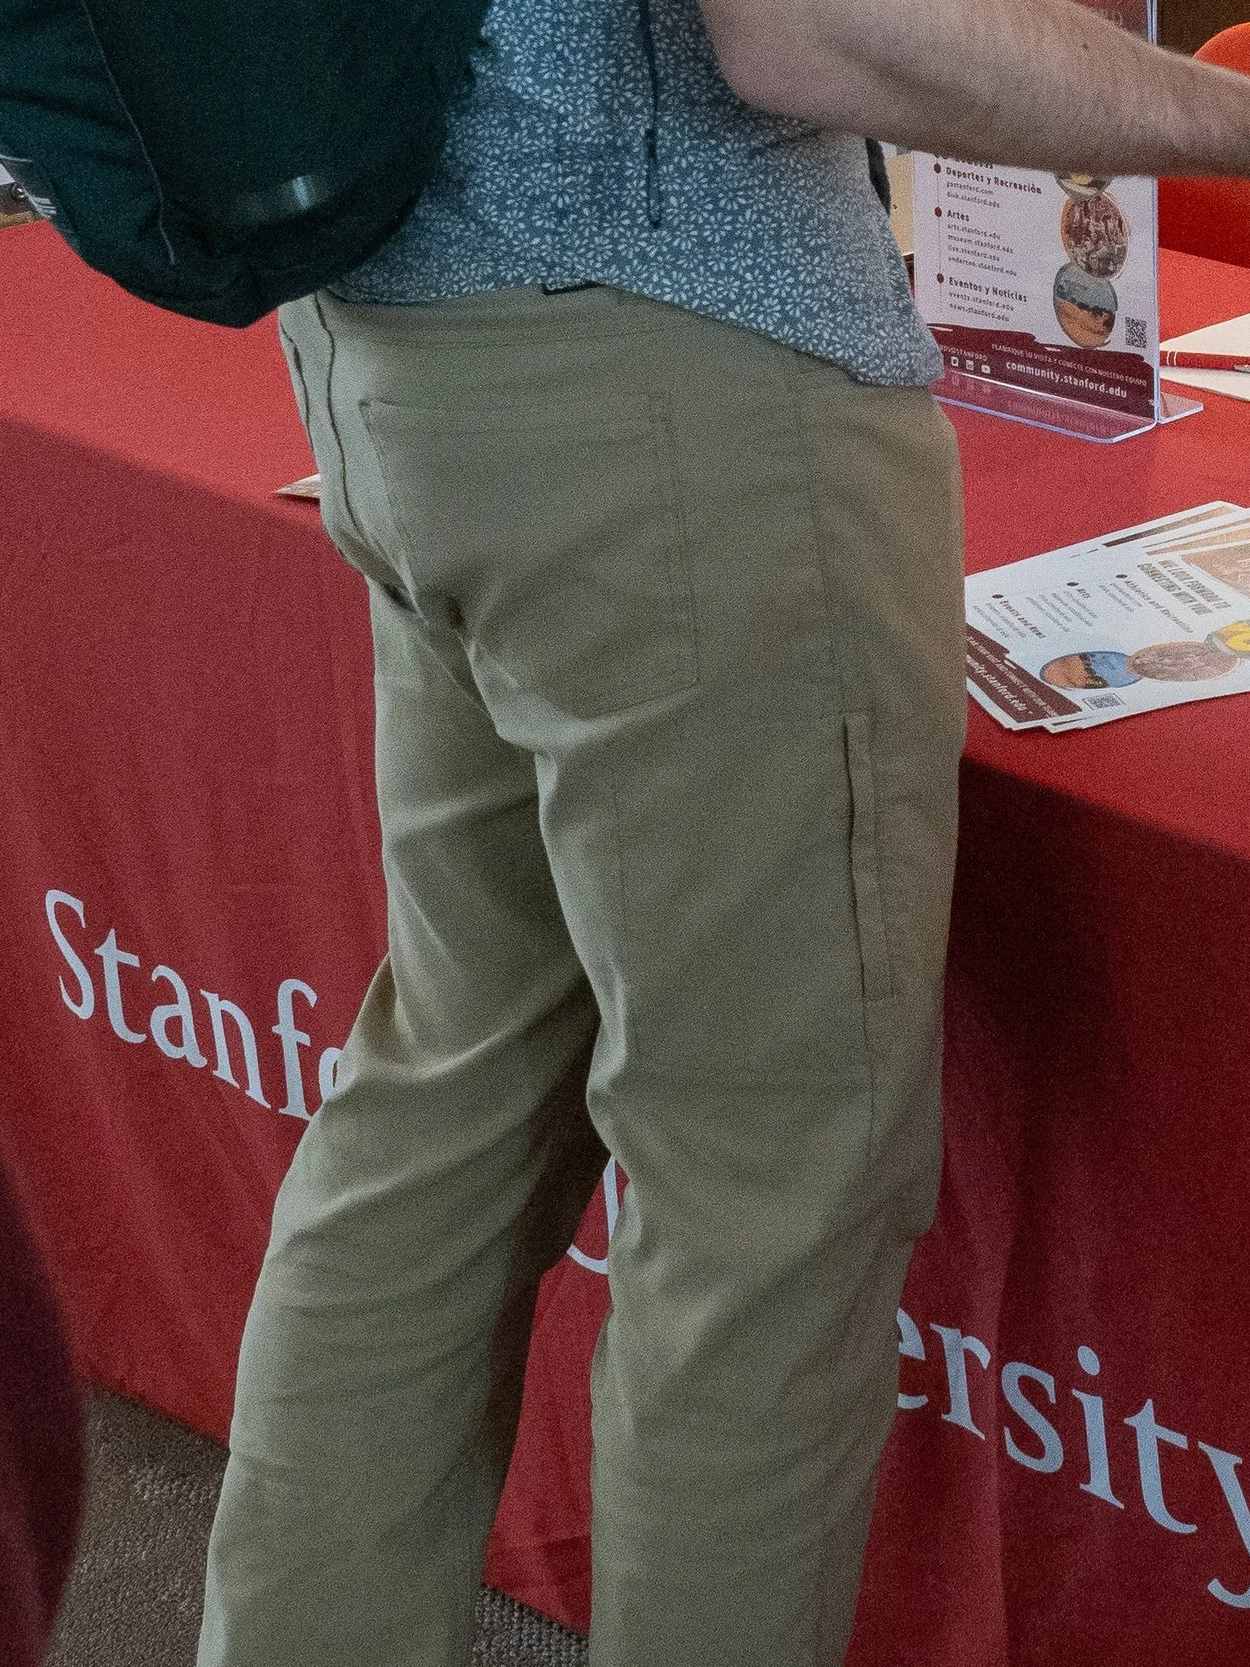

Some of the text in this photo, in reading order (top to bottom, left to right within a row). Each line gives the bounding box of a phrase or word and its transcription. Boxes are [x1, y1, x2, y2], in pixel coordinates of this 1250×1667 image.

[945, 166, 984, 183] Deportes
[985, 175, 991, 185] y
[946, 208, 970, 222] Artes
[948, 275, 982, 293] Eventos
[984, 285, 990, 295] y
[1005, 360, 1129, 399] community.stanford.edu
[44, 889, 346, 1121] Stanfo
